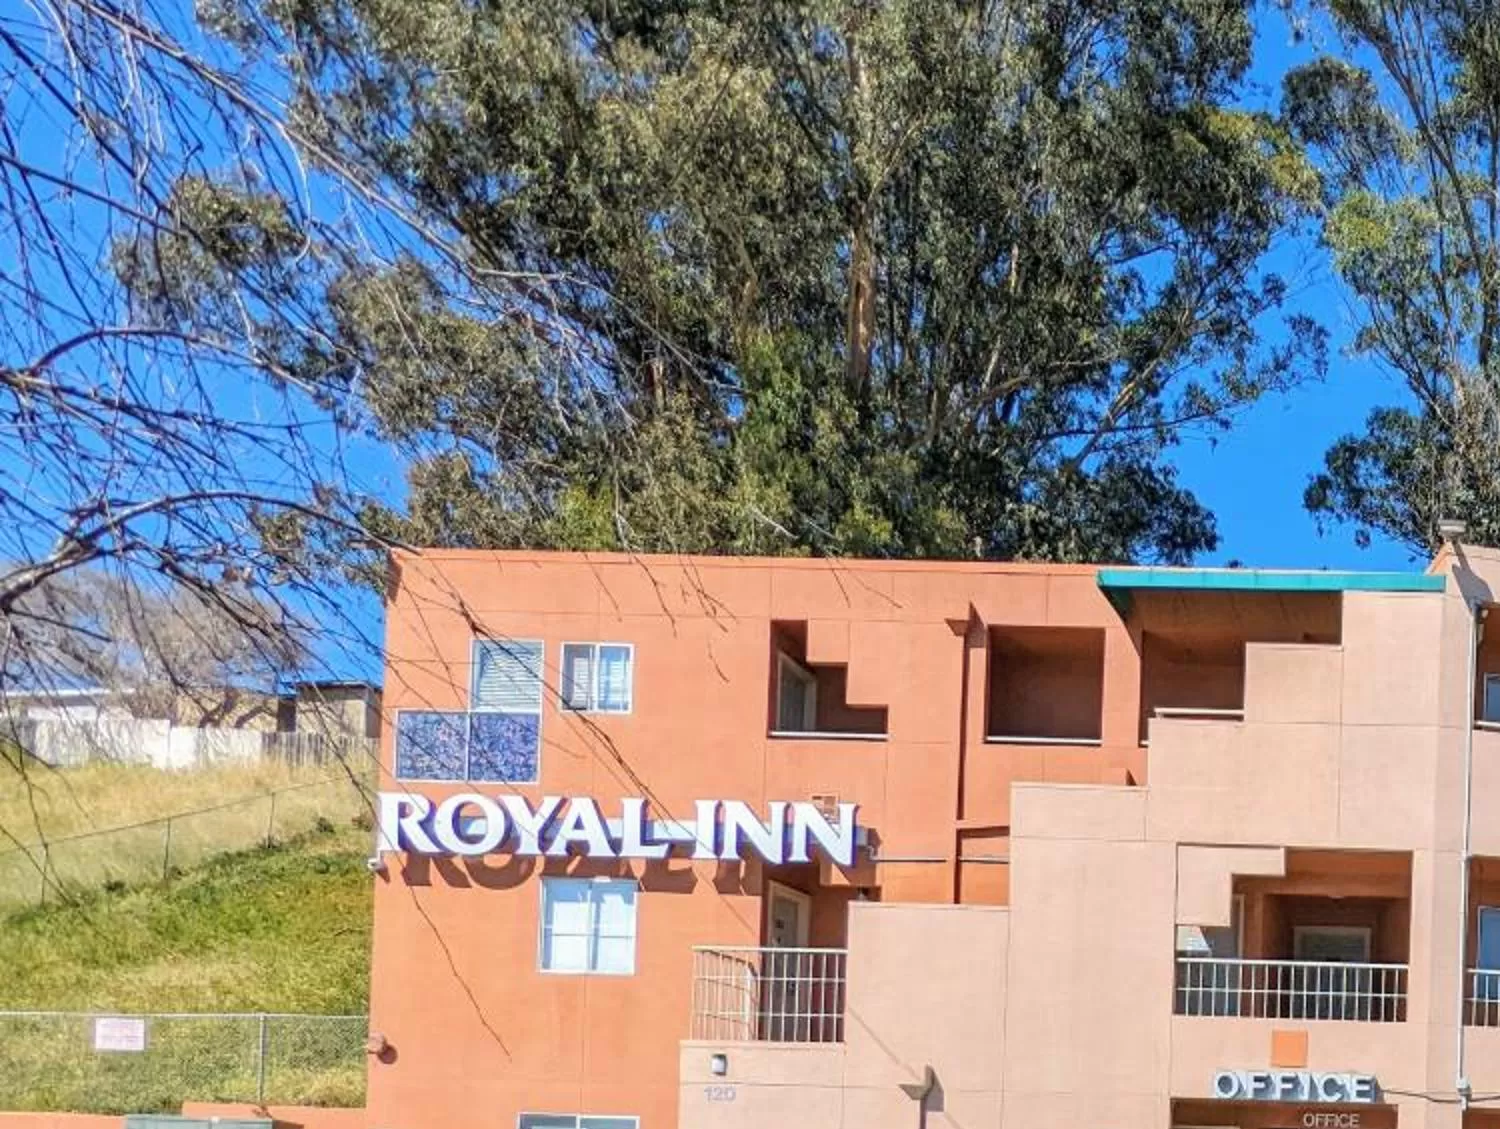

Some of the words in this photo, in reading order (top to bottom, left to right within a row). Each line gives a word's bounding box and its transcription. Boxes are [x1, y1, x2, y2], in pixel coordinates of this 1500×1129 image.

[377, 792, 672, 858] ROYAL
[693, 799, 860, 867] INN
[703, 1086, 737, 1102] 120
[1213, 1071, 1376, 1104] OFFICE
[1303, 1113, 1361, 1128] OFFICE
